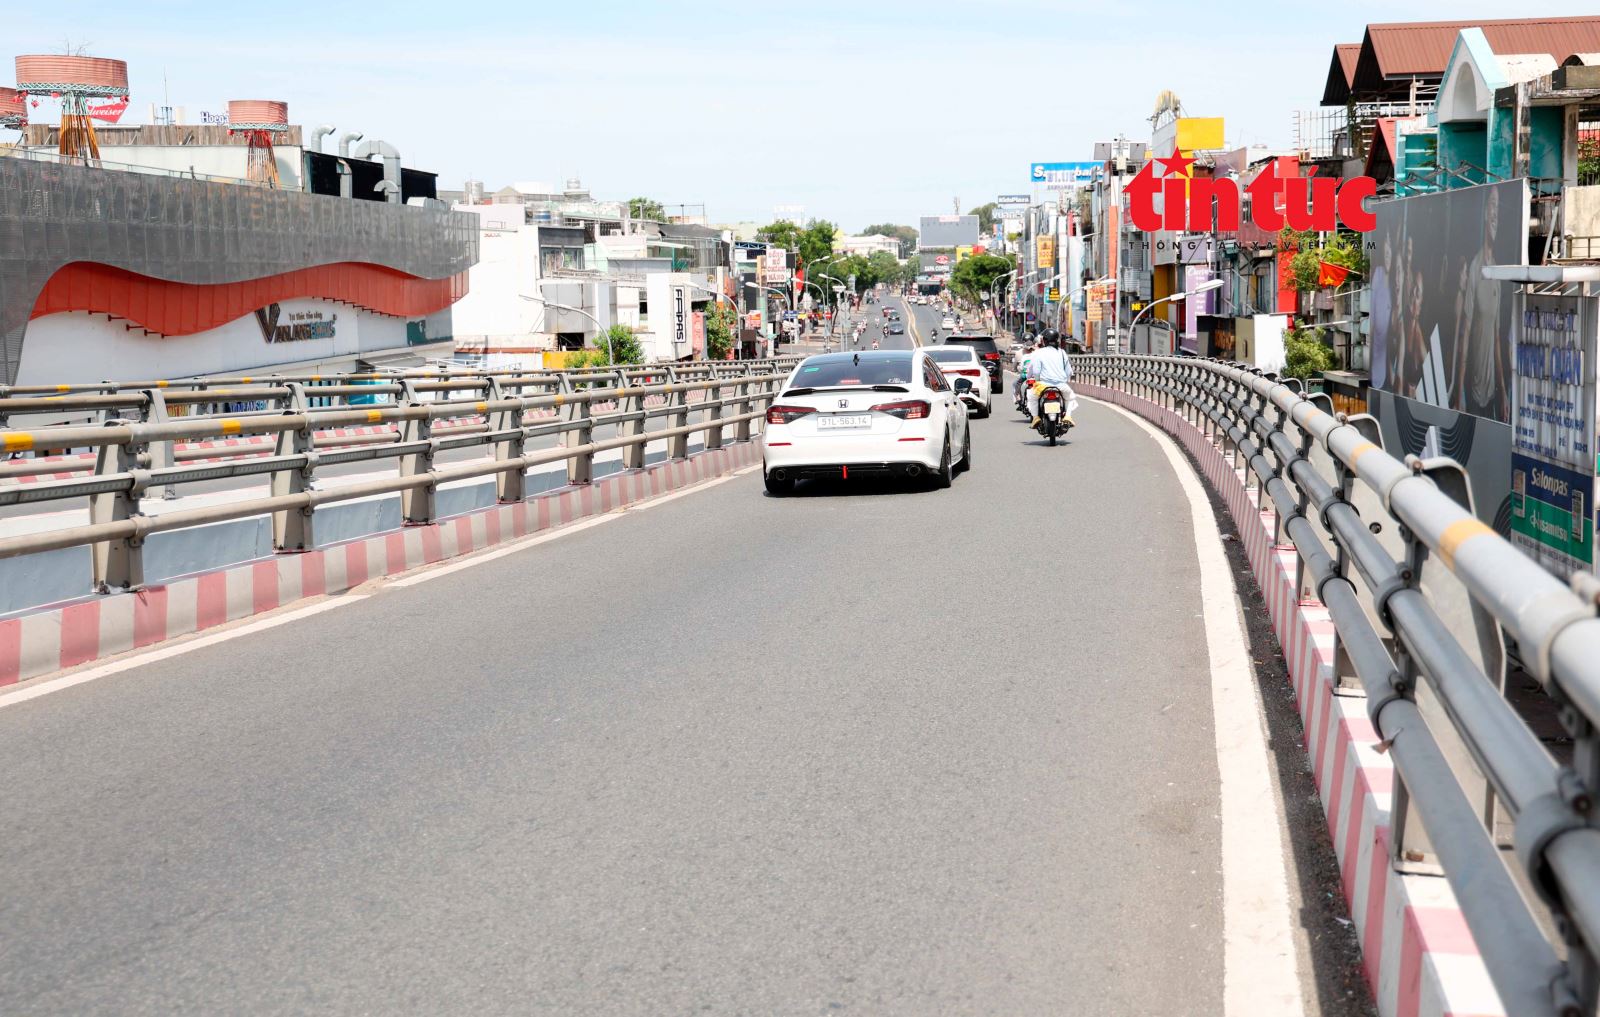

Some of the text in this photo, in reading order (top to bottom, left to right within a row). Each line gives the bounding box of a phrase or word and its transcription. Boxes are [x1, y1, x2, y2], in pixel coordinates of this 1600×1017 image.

[88, 105, 124, 116] dweiser
[200, 111, 230, 126] Hoega
[821, 416, 868, 427] 51L-563.14
[1531, 467, 1569, 497] Salonpas
